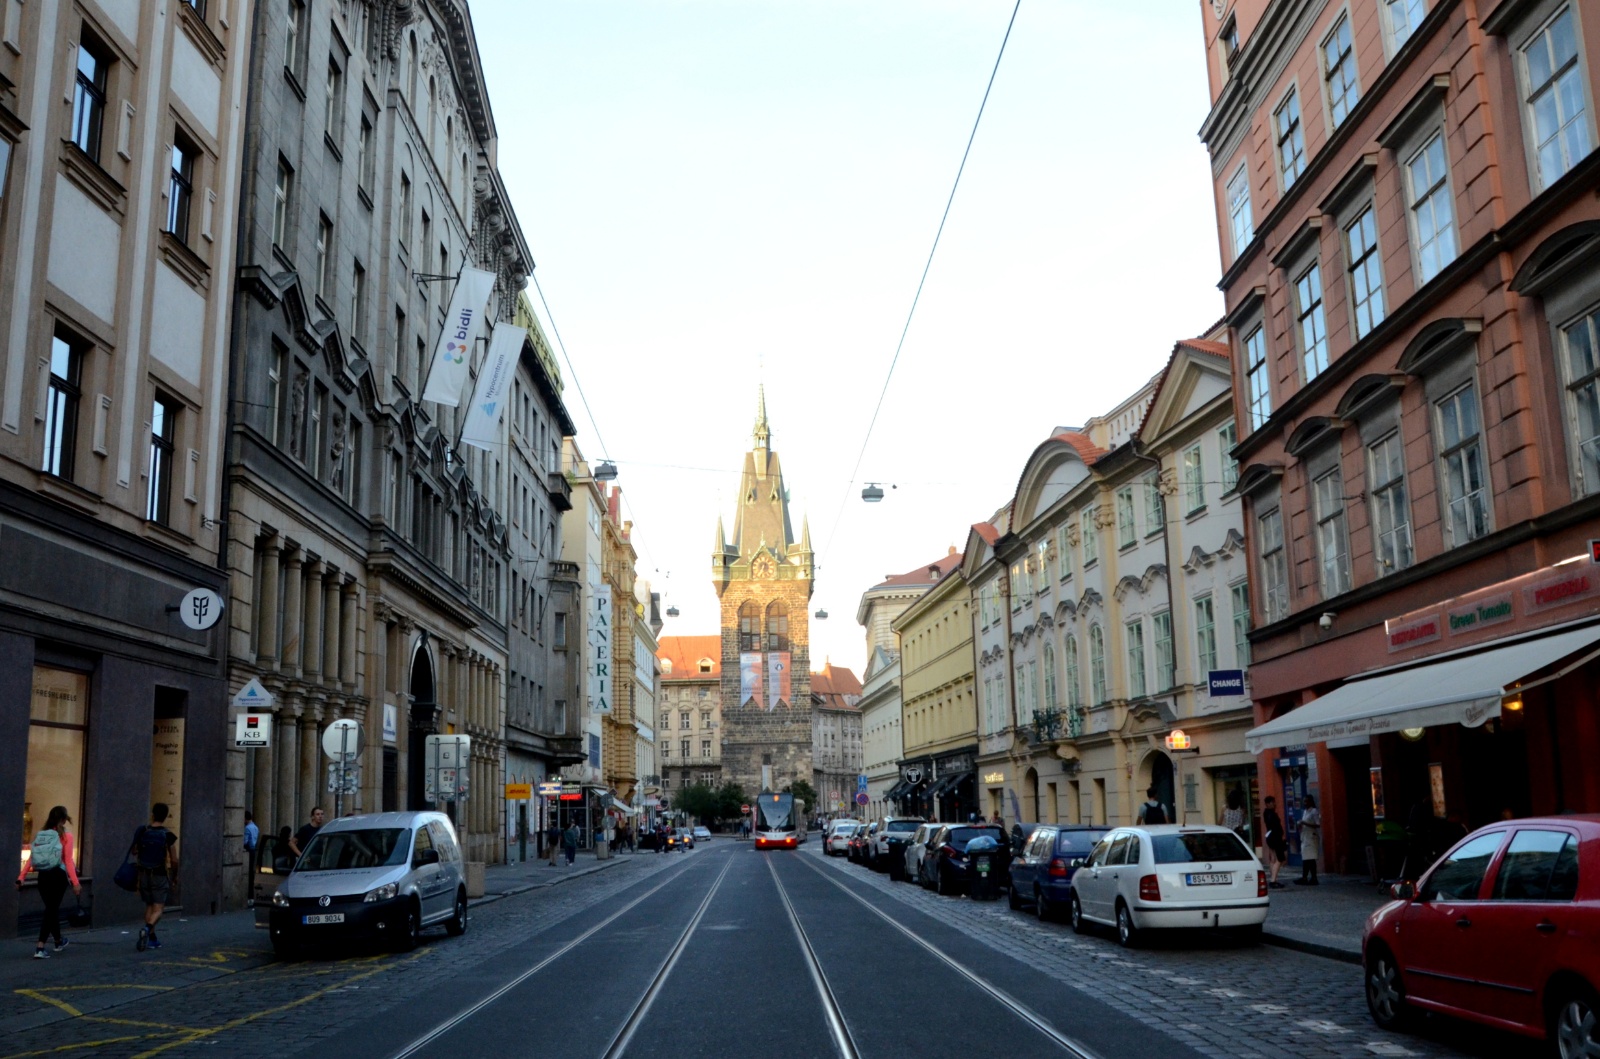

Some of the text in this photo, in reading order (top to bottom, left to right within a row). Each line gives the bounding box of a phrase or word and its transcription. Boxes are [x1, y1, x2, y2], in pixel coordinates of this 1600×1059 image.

[454, 308, 473, 340] bidli
[485, 354, 504, 399] Hypocentrum
[1450, 601, 1512, 630] Green Tomato
[596, 597, 609, 709] PANERIA
[1211, 679, 1242, 688] CHANGE
[35, 689, 77, 702] FRESHLABELS
[1210, 874, 1229, 883] 5315
[307, 914, 342, 923] 8U9 9034
